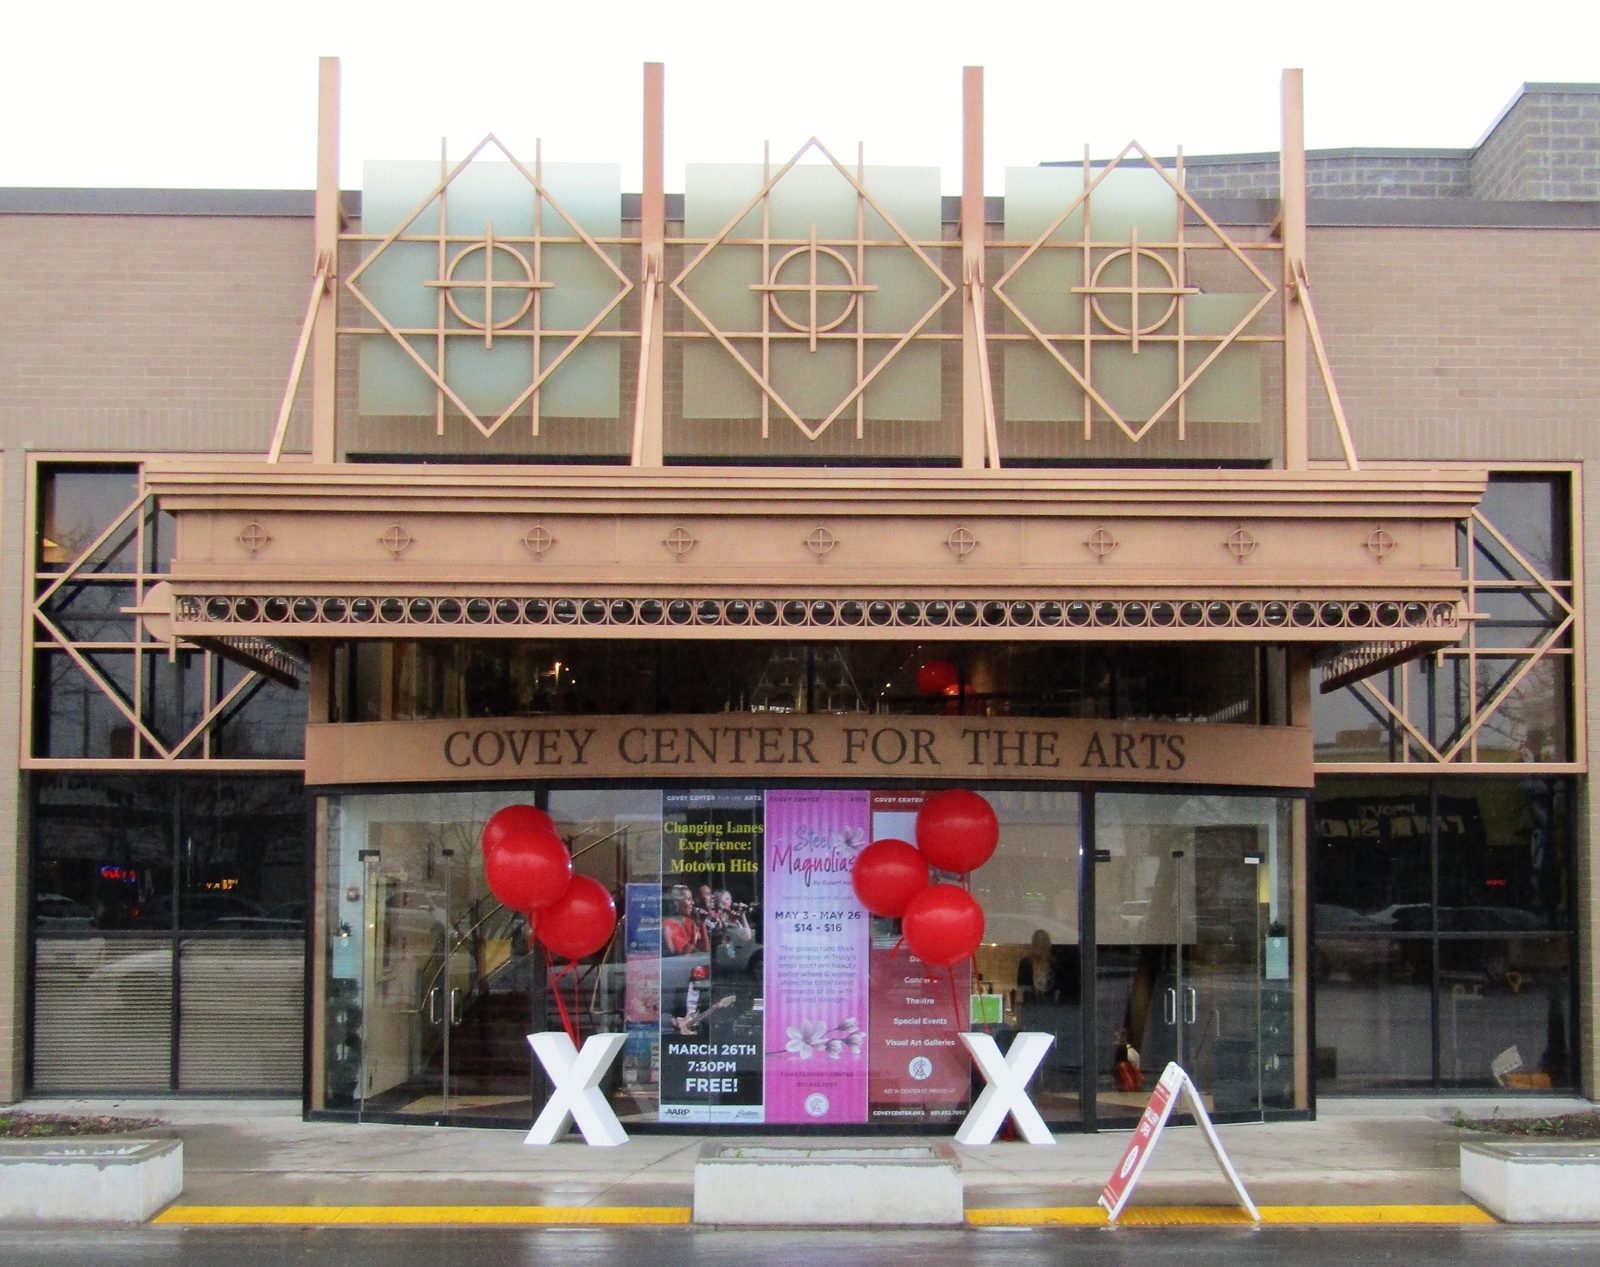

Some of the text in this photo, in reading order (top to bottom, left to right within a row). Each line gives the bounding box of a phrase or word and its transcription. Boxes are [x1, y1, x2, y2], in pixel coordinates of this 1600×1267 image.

[444, 727, 1186, 771] COVEY CENTER FOR THE ARTS
[664, 821, 764, 836] Changing Lanes
[794, 825, 832, 853] Steel
[678, 838, 752, 853] Experience:
[670, 859, 759, 873] Motown Hits
[775, 911, 799, 920] MAY
[802, 911, 809, 920] 3
[820, 911, 844, 920] MAY
[847, 911, 862, 920] 26
[794, 923, 813, 932] $14
[824, 923, 842, 932] $16
[893, 1017, 920, 1025] Special
[668, 1044, 756, 1055] MARCH 26TH
[688, 1061, 737, 1072] 7:30PM
[685, 1078, 738, 1092] FREE!
[665, 1108, 690, 1116] AARP
